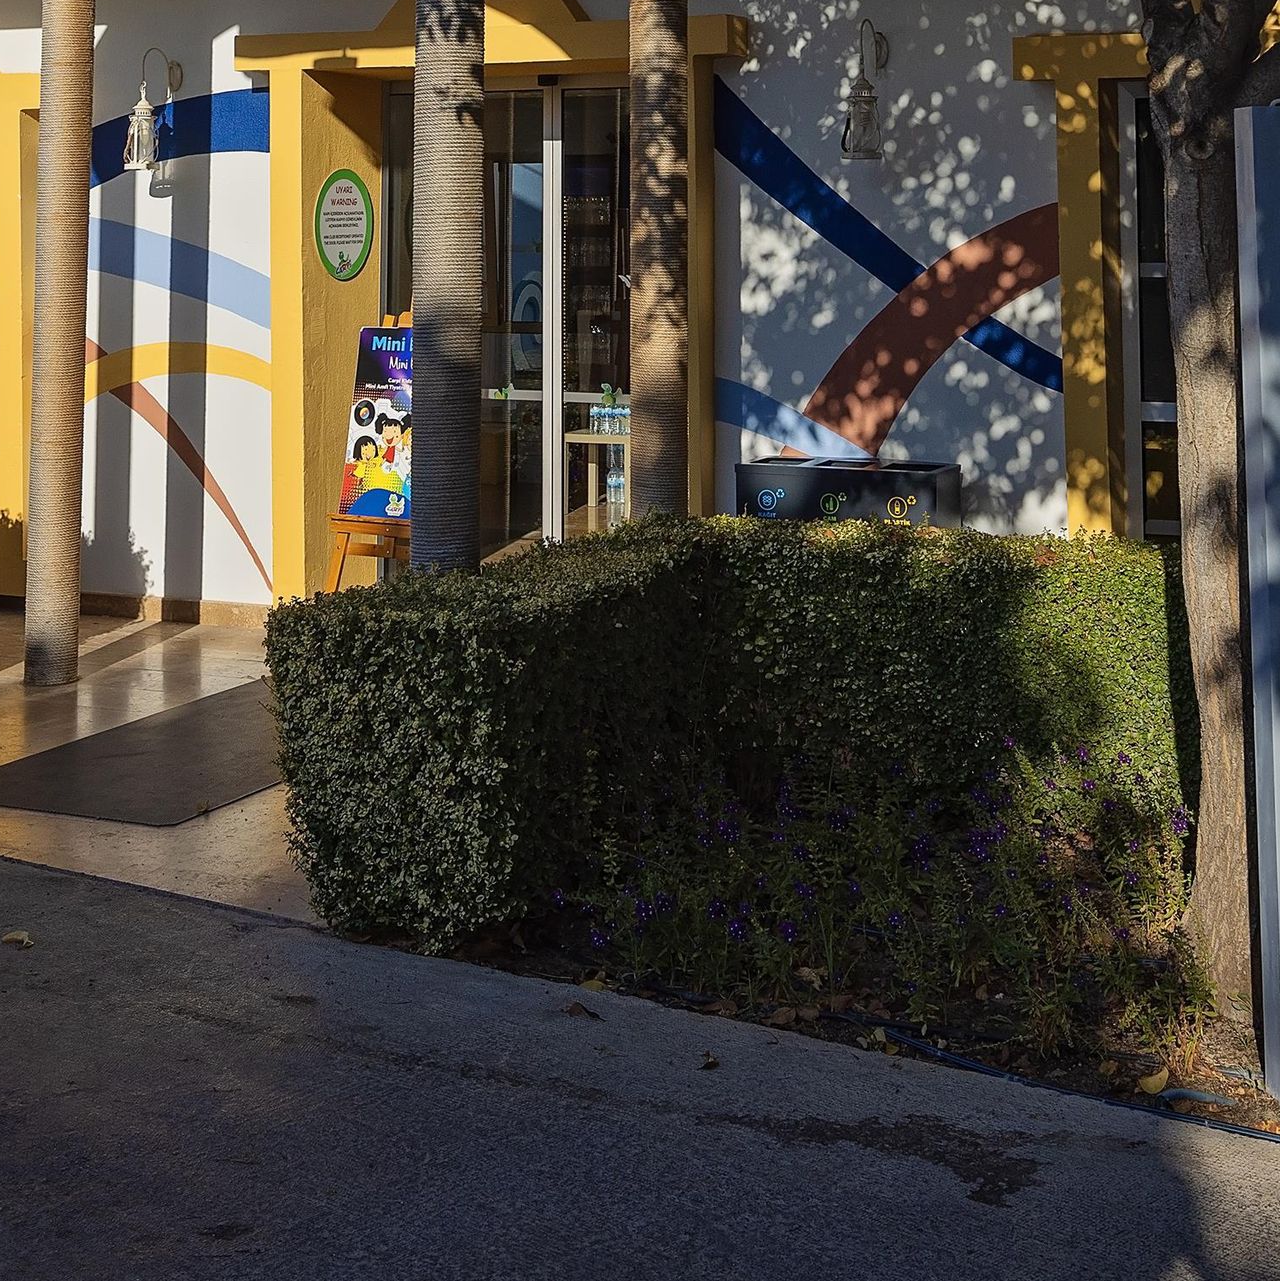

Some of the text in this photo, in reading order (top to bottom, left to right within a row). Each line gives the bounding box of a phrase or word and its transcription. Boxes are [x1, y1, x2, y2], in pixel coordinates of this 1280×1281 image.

[330, 198, 358, 207] WARNING
[372, 335, 407, 352] Mini
[389, 355, 409, 371] Mini
